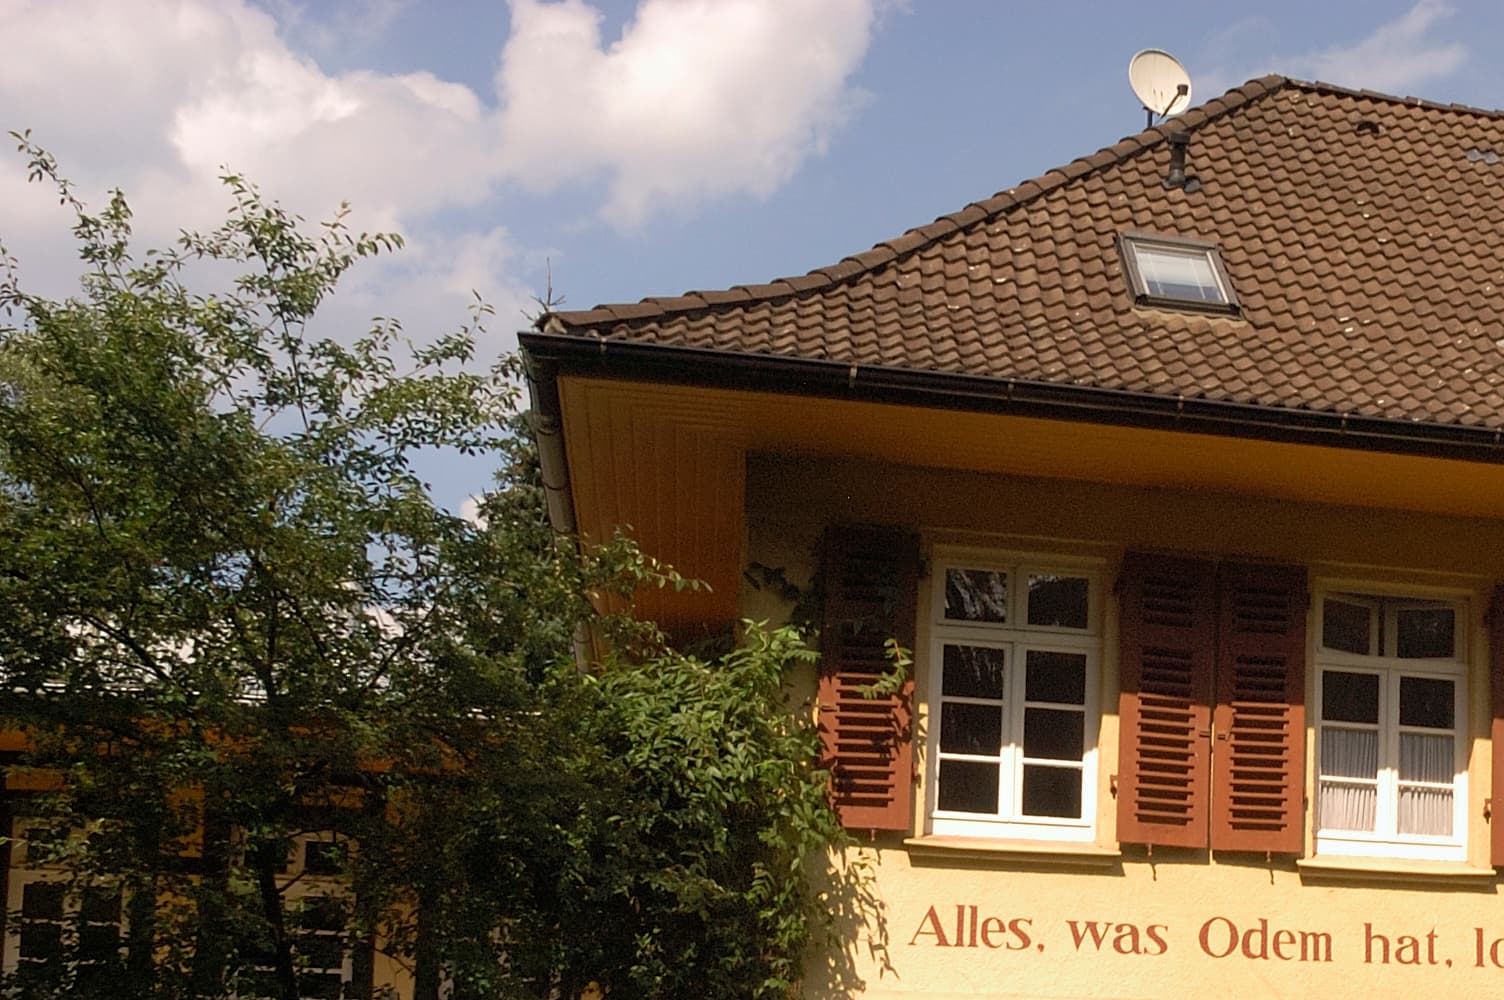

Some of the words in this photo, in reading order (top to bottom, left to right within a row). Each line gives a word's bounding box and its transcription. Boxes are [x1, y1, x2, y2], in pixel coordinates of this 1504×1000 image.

[908, 903, 1045, 953] Alles,
[1065, 920, 1169, 956] was
[1198, 916, 1333, 963] Odem
[1363, 922, 1454, 969] hat,
